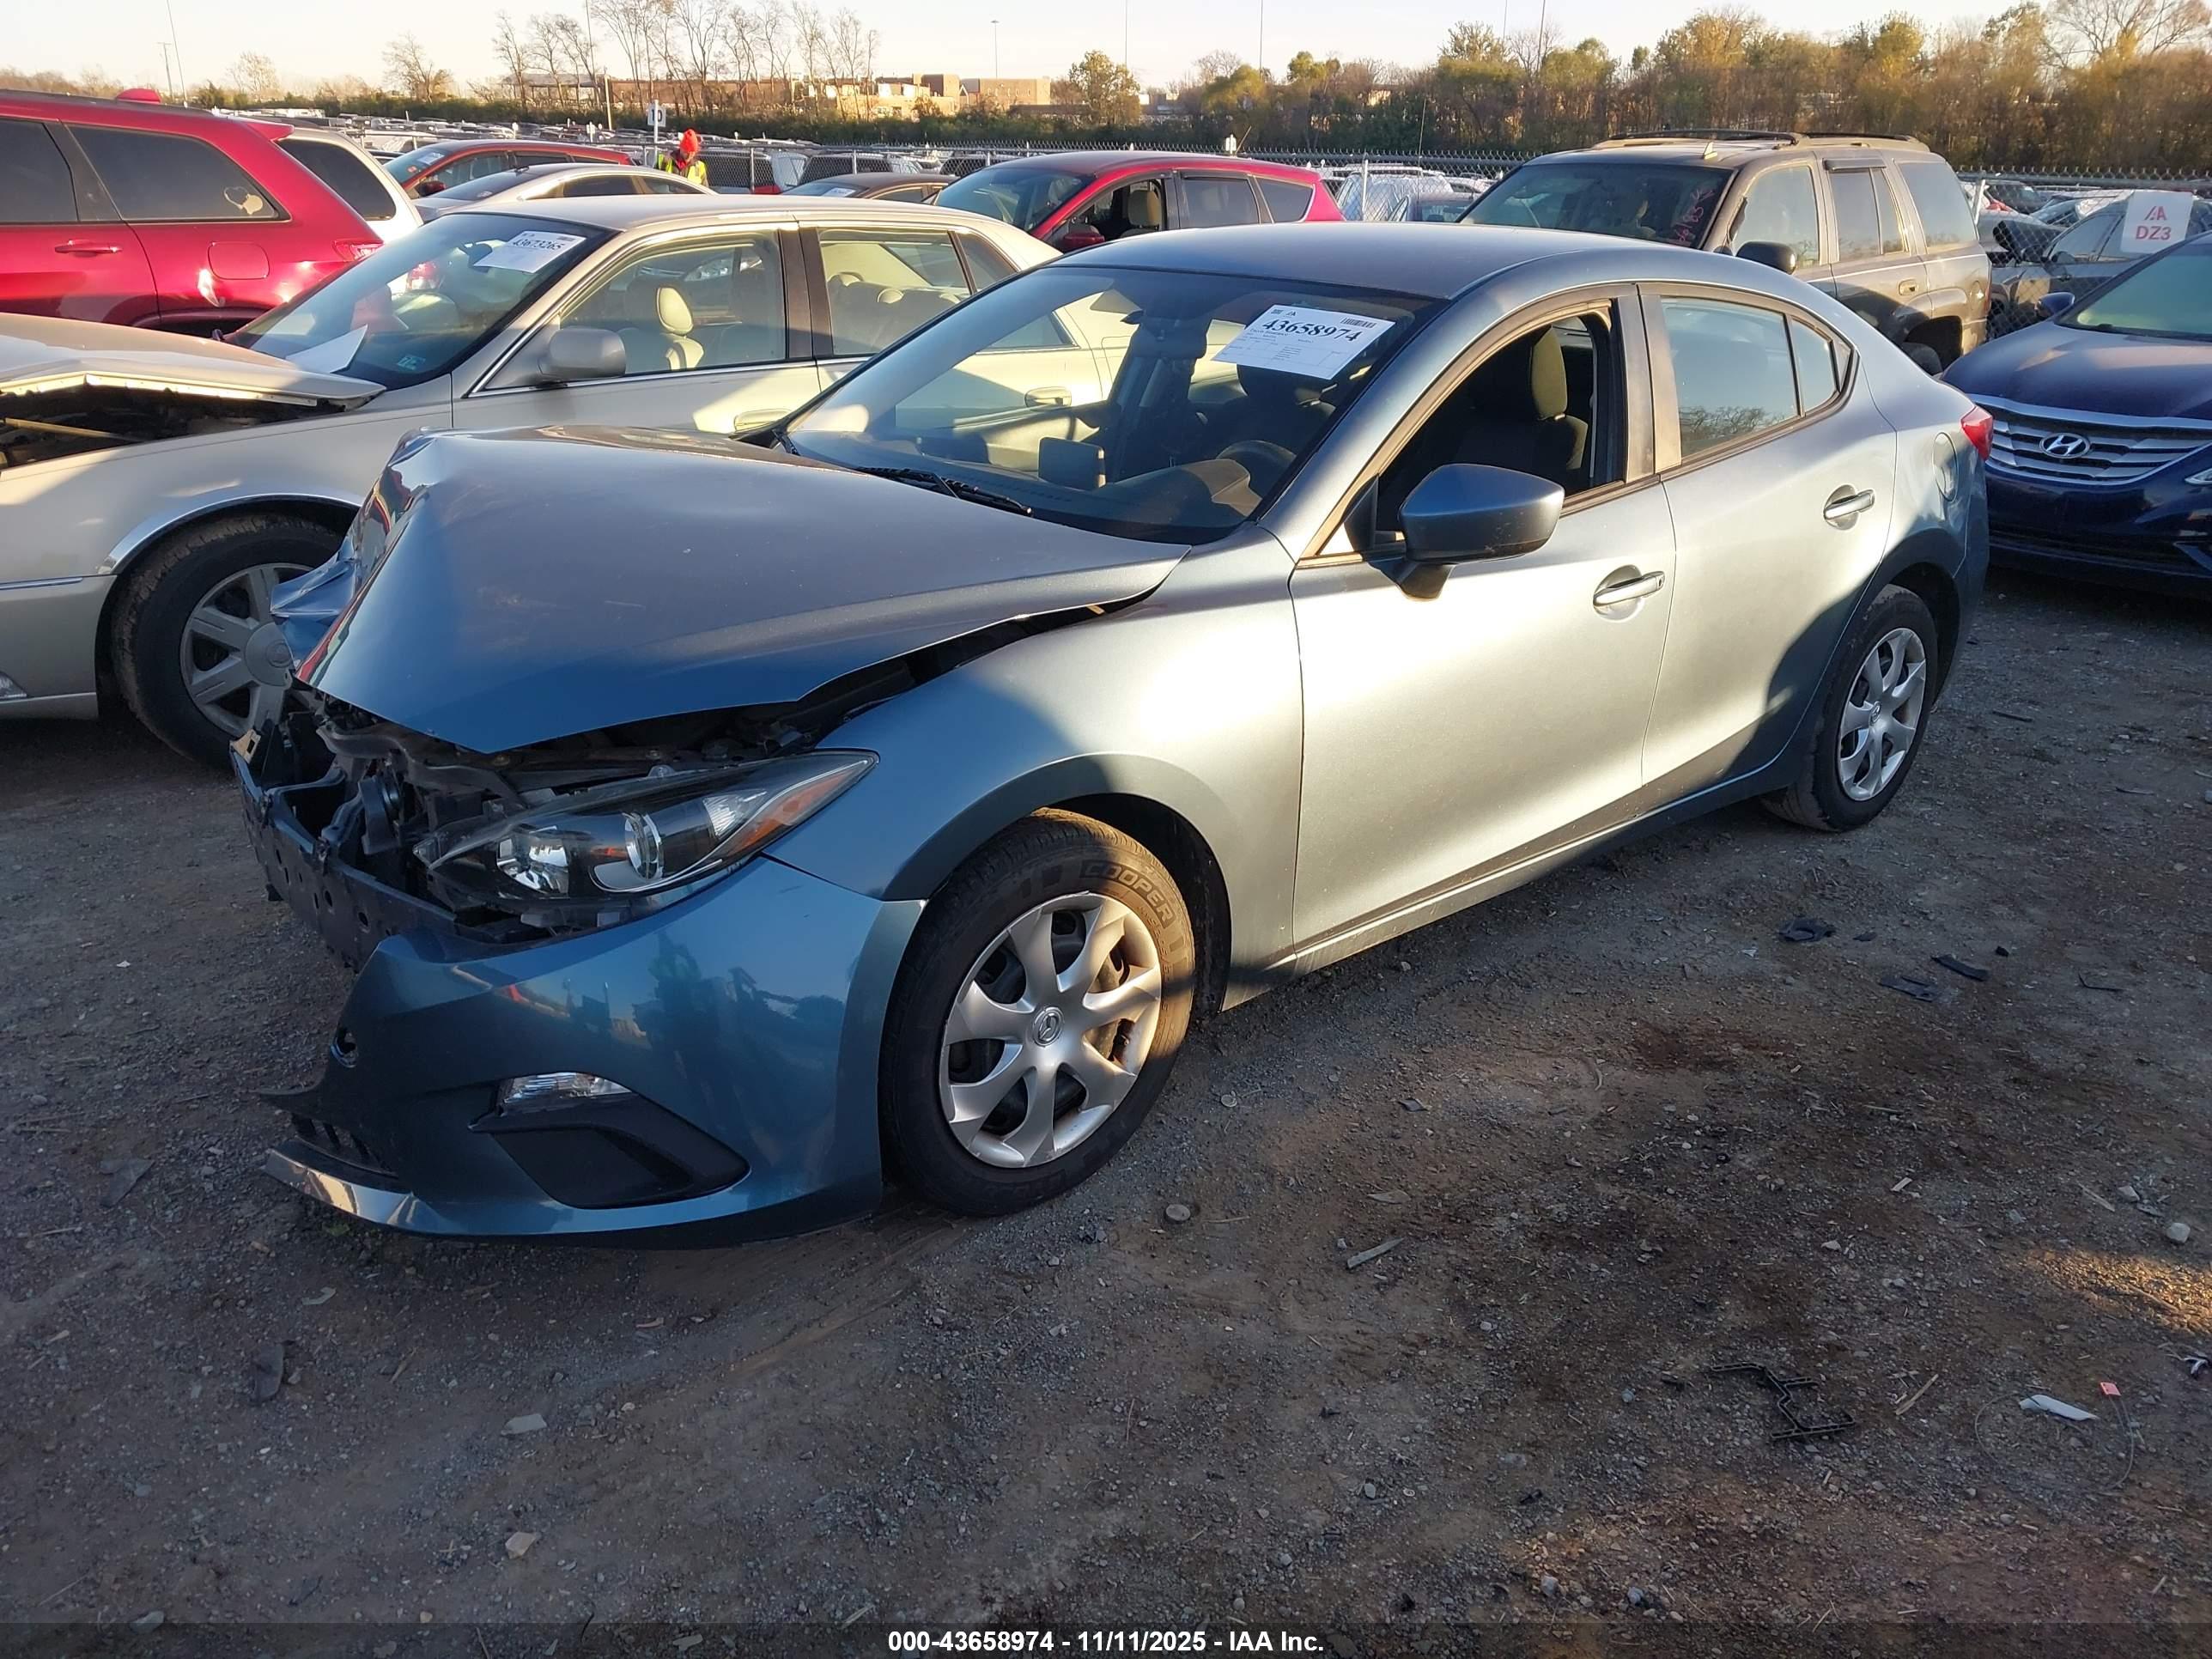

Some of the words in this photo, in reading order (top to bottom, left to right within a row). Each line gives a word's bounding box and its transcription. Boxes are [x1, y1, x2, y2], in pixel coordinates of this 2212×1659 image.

[2136, 225, 2172, 240] DZ3
[1261, 318, 1363, 342] 43658974
[1084, 860, 1175, 922] COOPER
